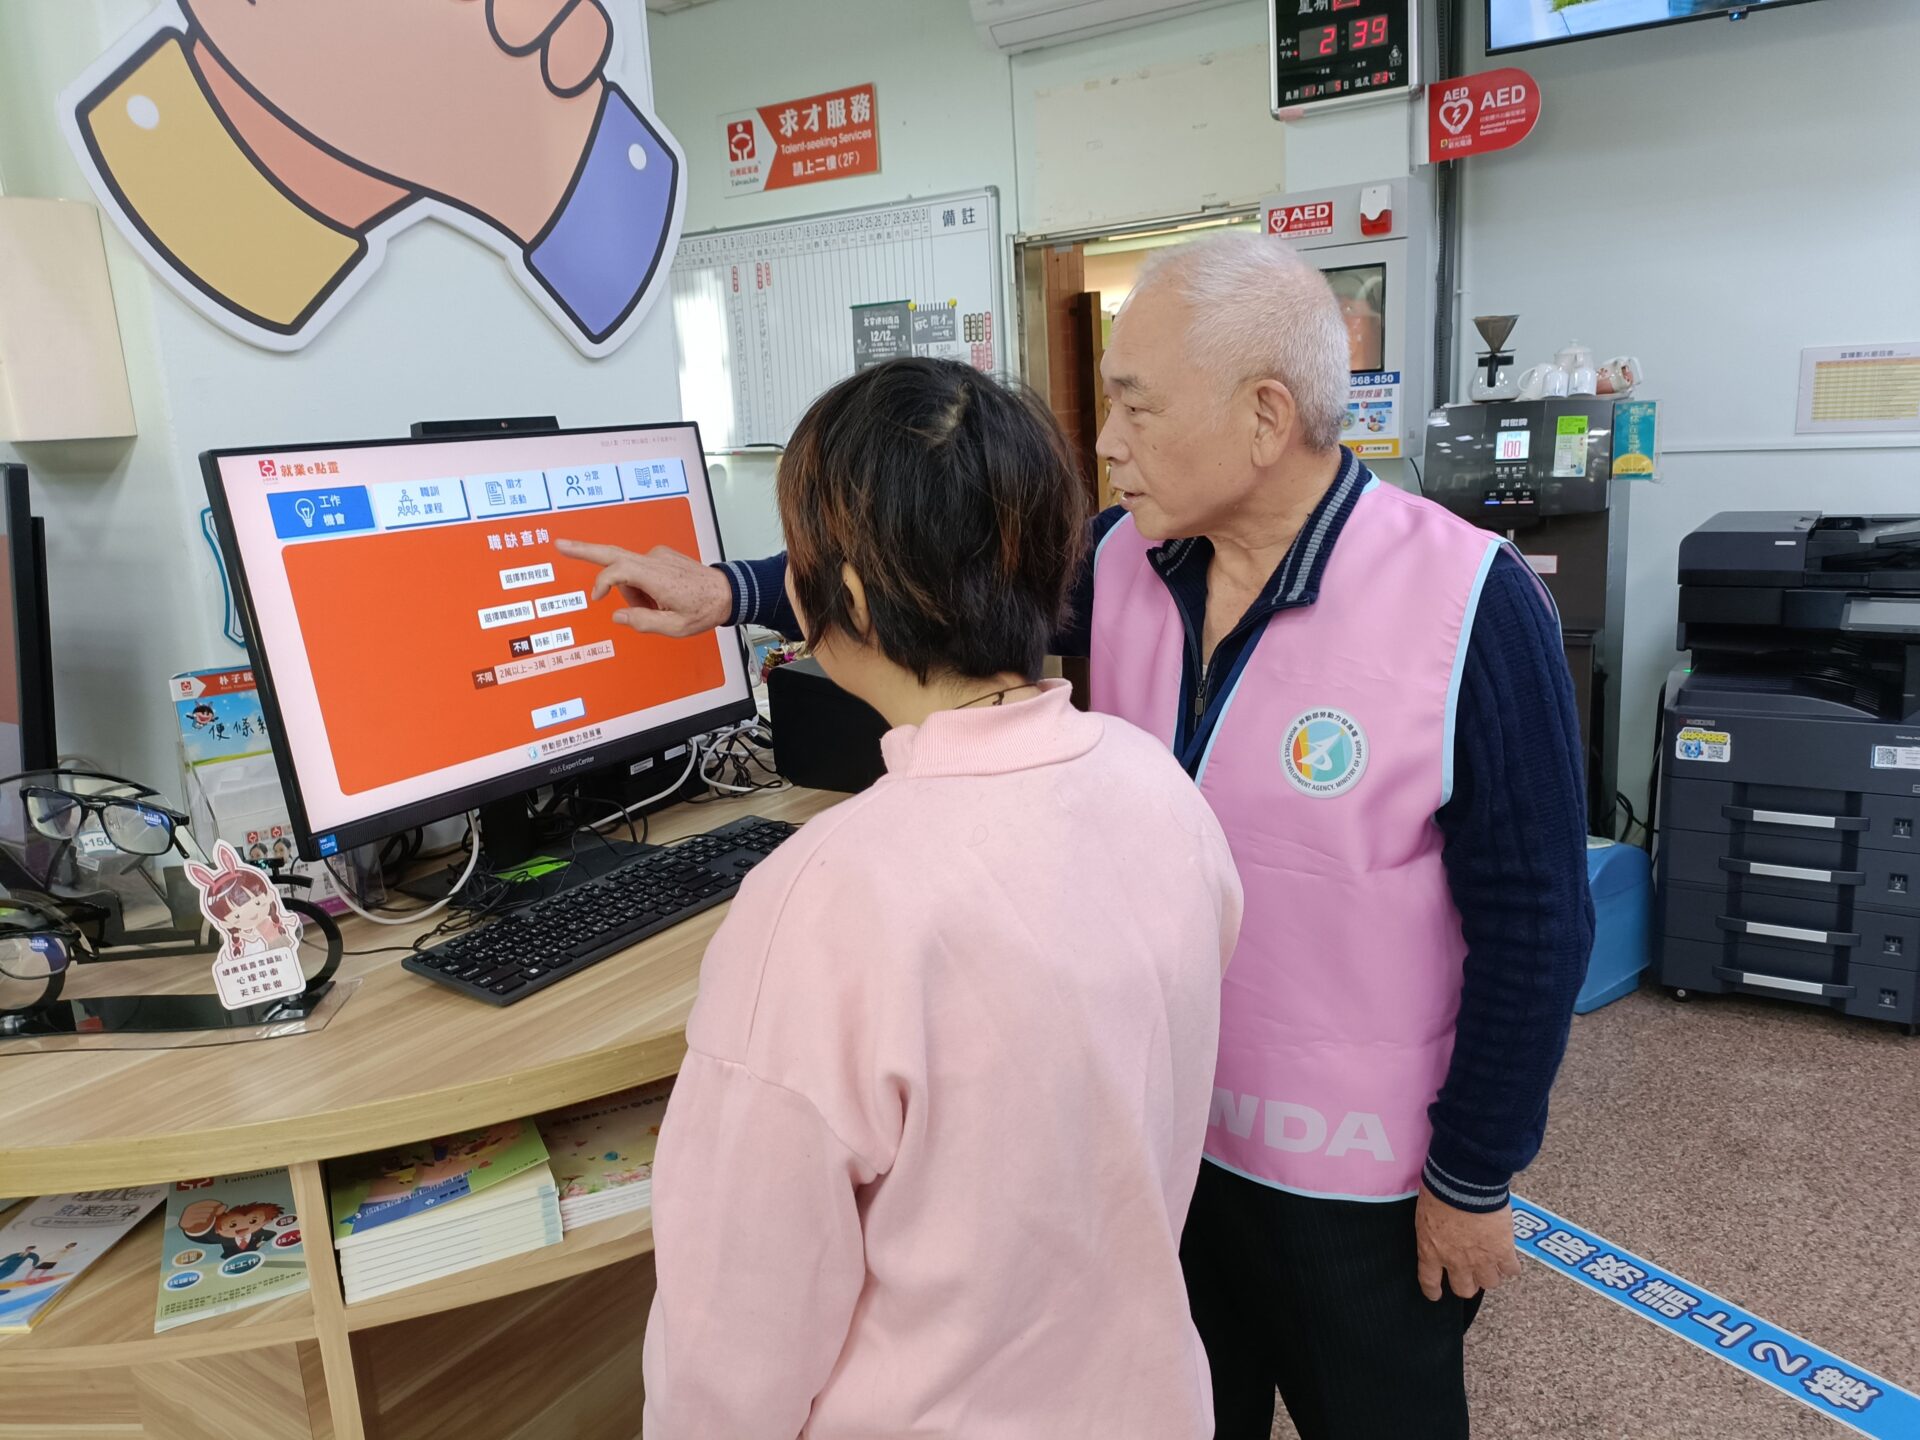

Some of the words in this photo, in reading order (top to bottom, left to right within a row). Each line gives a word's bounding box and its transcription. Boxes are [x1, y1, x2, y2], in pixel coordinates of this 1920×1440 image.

[1444, 87, 1469, 102] AED
[1481, 85, 1526, 110] AED
[779, 93, 871, 138] 求才服務
[781, 137, 838, 154] Talent-seeking
[838, 128, 872, 144] Services
[792, 151, 861, 177] 請上二樓(2F)
[942, 206, 976, 227] 備註
[1290, 204, 1330, 222] AED
[914, 320, 929, 331] KFC
[870, 330, 892, 342] 12/12
[1504, 440, 1521, 458] 100
[281, 461, 340, 477] 就業e點靈
[584, 470, 600, 481] 分眾
[420, 486, 440, 497] 職訓
[505, 478, 522, 489] 徵才
[587, 485, 603, 497] 類別
[655, 478, 670, 489] 我們
[319, 494, 341, 508] 工作
[509, 494, 527, 506] 活動
[424, 503, 444, 514] 課程
[323, 512, 345, 527] 機會
[487, 528, 550, 551] 職缺查詢
[505, 568, 549, 584] 選擇教育程度
[540, 595, 583, 612] 選擇工作地點
[513, 641, 530, 653] 不限
[555, 631, 570, 644] 月薪
[476, 671, 494, 684] 不限
[586, 643, 611, 658] 4萬以上
[549, 706, 567, 719] 查詢
[1299, 711, 1358, 738] 勞動部勞動力發展署
[542, 728, 602, 753] 勞動部勞動力發展署
[1285, 758, 1312, 789] DEVELOPMENT
[1336, 768, 1357, 788] MINISTRY
[1353, 759, 1361, 768] OF
